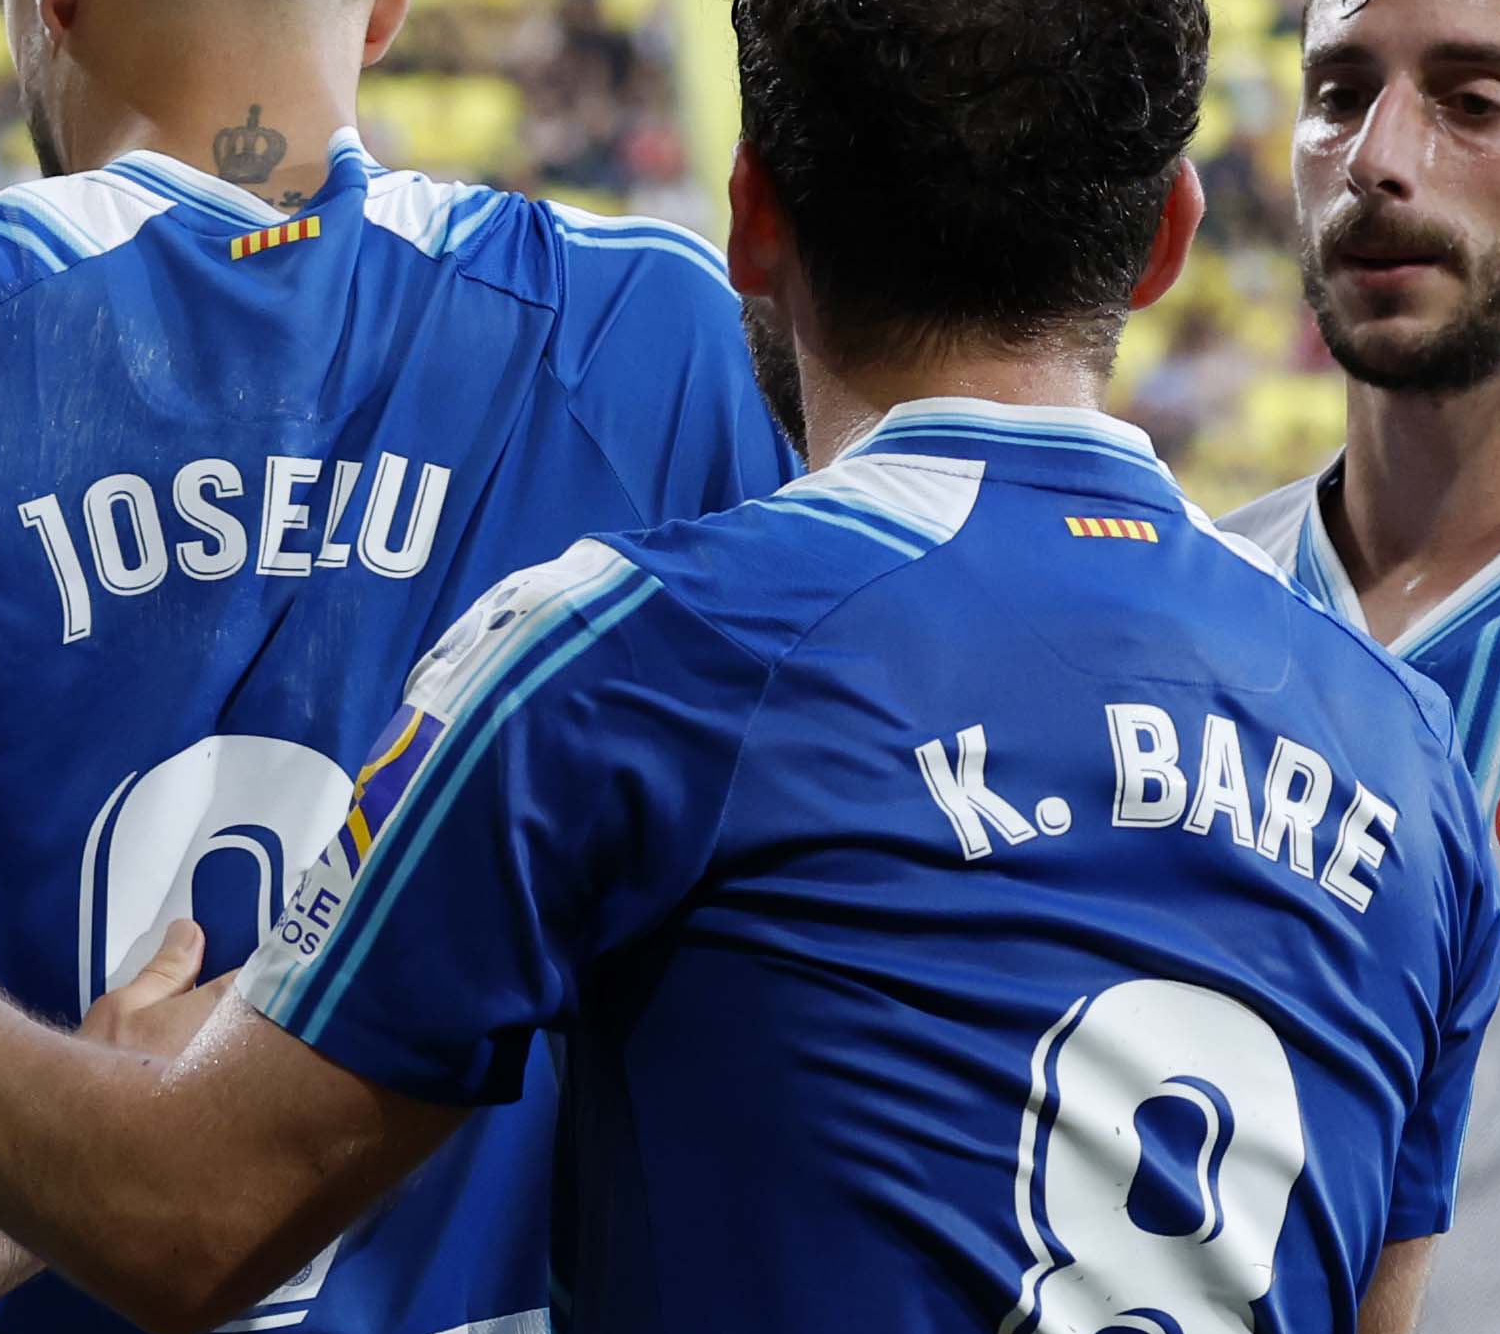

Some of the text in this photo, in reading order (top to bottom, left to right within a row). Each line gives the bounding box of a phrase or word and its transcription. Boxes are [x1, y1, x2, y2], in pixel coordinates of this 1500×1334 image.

[18, 451, 451, 644] JOSELU
[914, 702, 1398, 913] K. BARE
